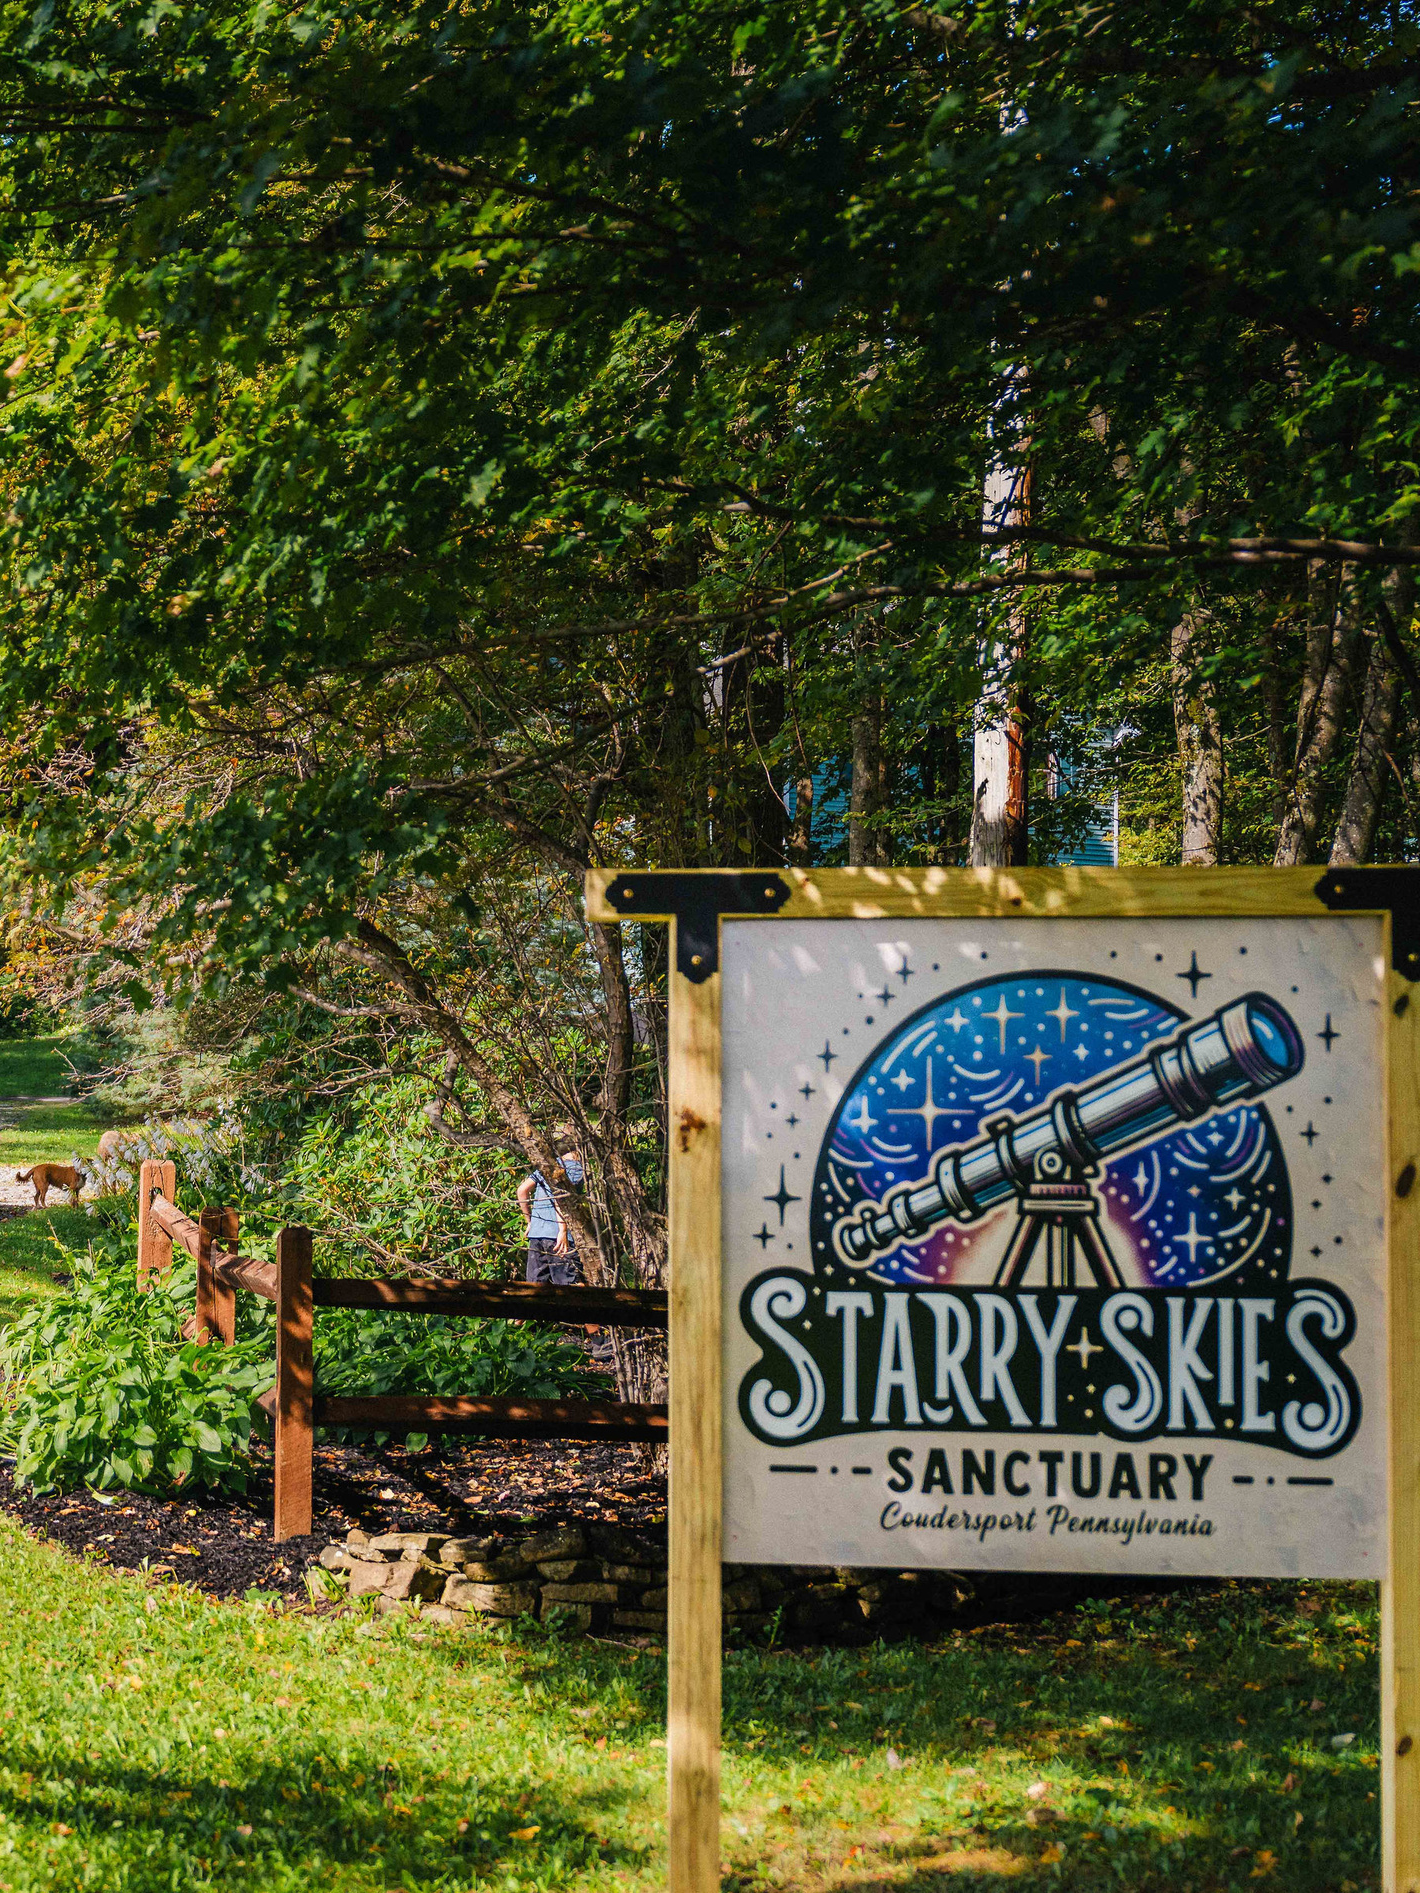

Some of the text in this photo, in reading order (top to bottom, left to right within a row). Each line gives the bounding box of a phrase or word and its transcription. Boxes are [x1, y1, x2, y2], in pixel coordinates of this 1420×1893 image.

[749, 1276, 1353, 1452] STARRY SKIES
[886, 1447, 1215, 1501] SANCTUARY
[879, 1501, 1215, 1546] Coudersport Pennsylvania
